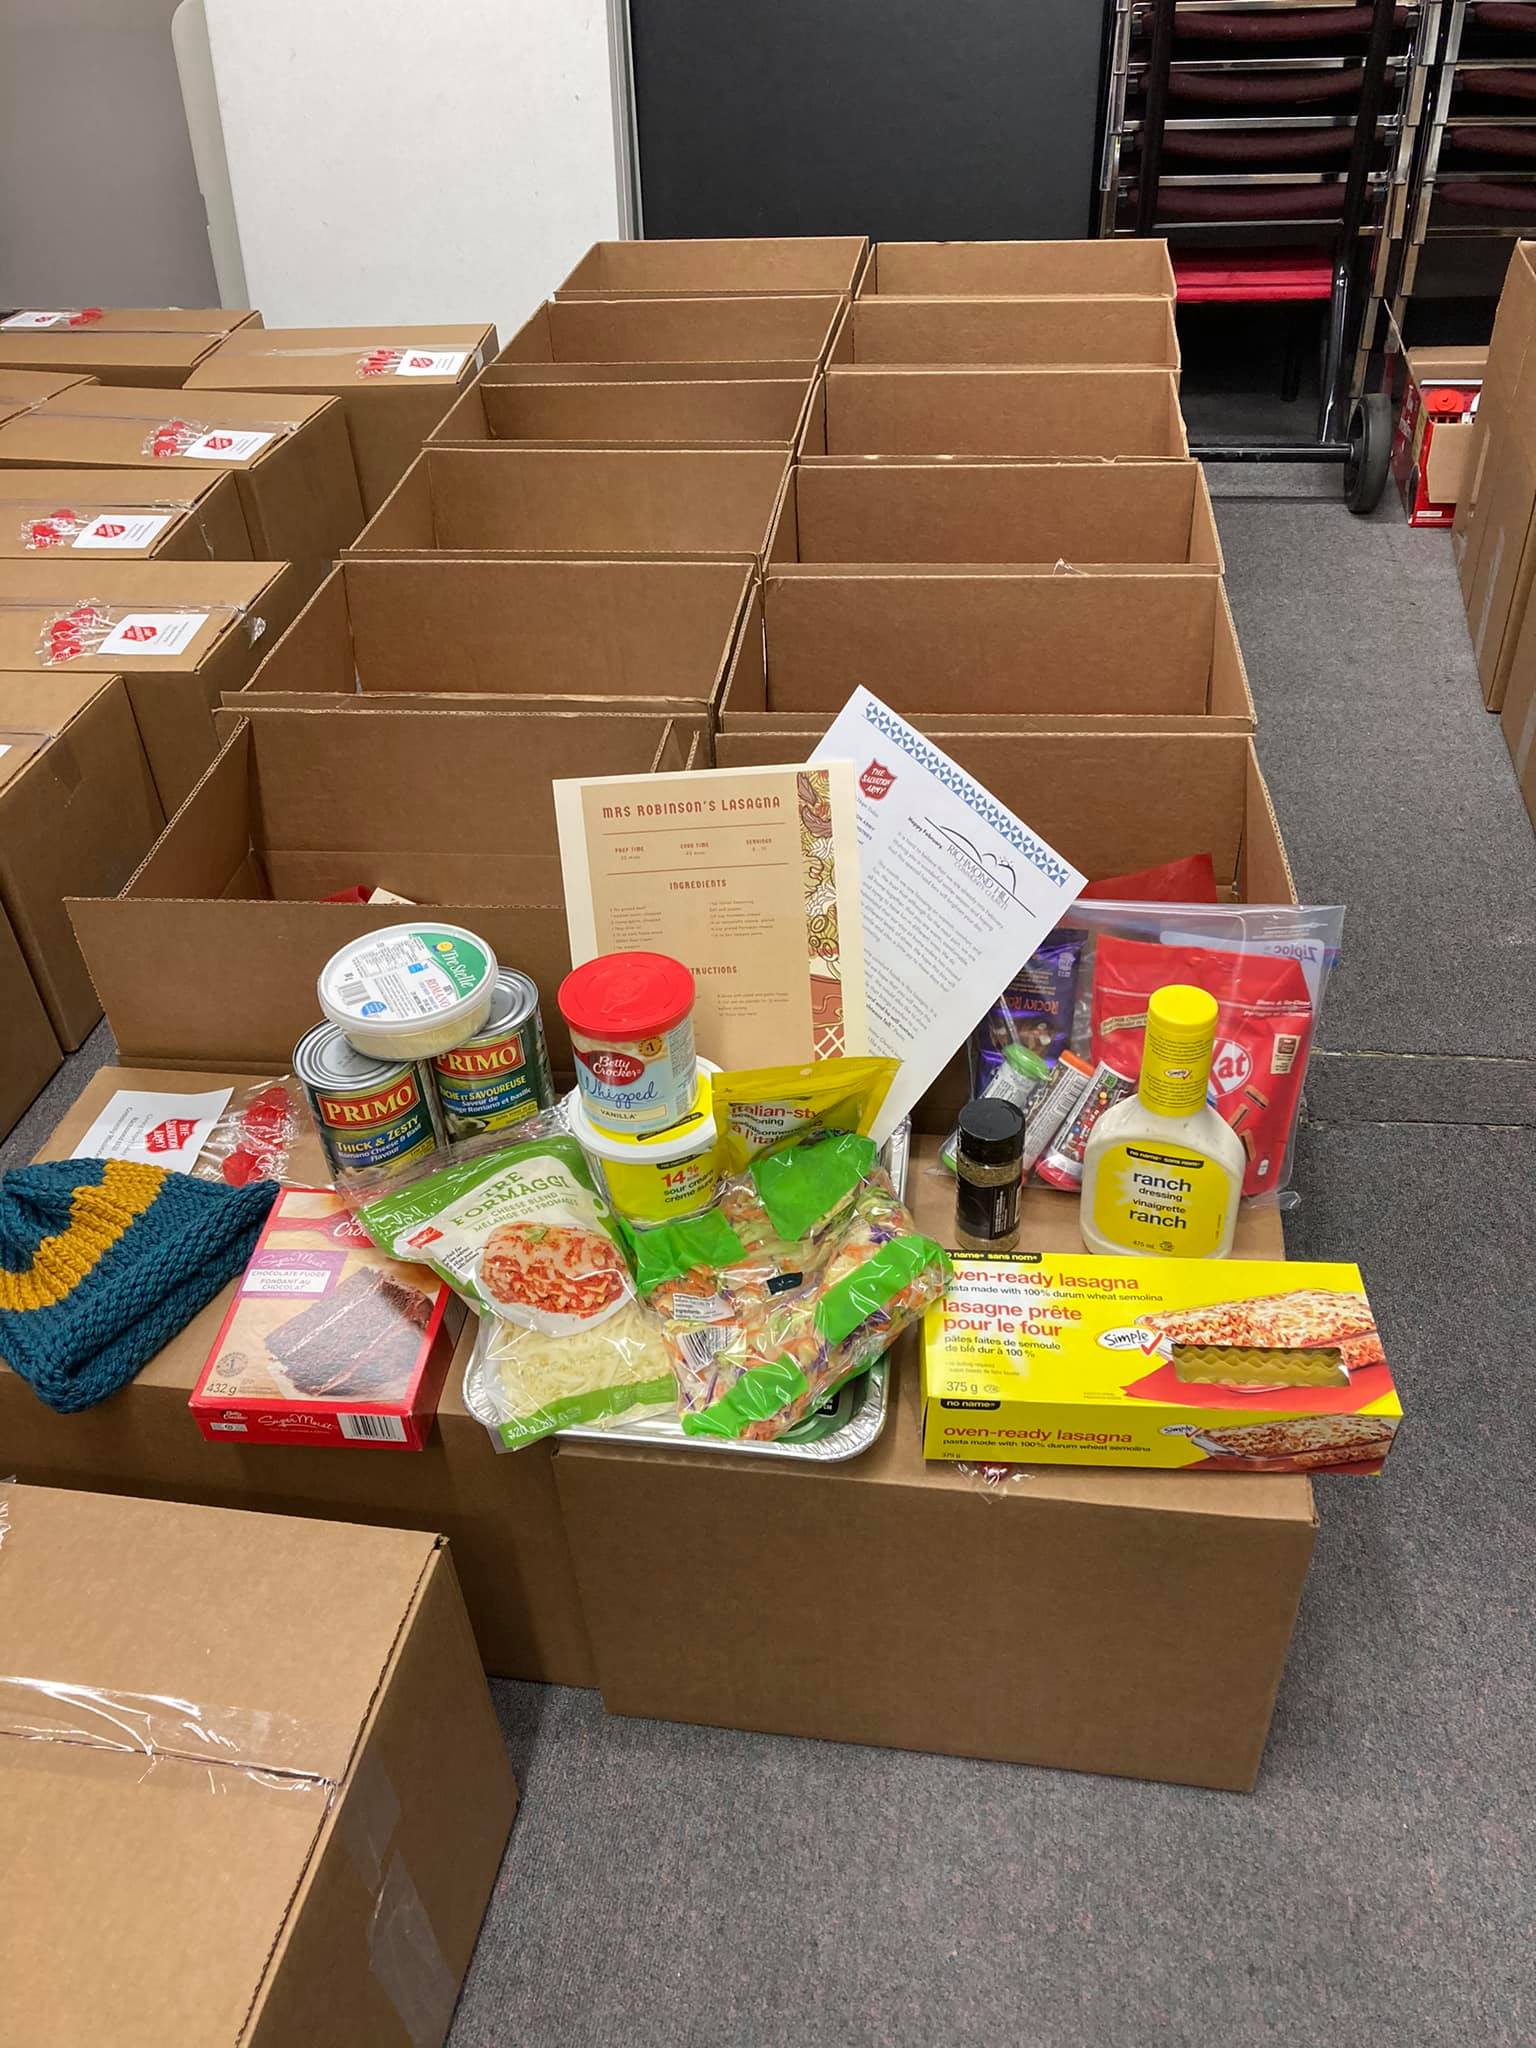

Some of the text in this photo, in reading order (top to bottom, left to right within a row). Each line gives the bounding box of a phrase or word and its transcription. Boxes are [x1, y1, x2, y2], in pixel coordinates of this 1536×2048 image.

[603, 796, 781, 819] MRS ROBINSON'S LASAGNA
[946, 844, 994, 889] RICHMOND
[669, 879, 727, 890] INGREDIENTS
[690, 965, 737, 976] TRUCTIONS
[436, 1046, 517, 1073] PRIMO
[599, 1056, 630, 1070] Betty
[592, 1062, 637, 1078] Crocker
[469, 1075, 527, 1100] SAVOUREUSE
[579, 1070, 658, 1109] Whipped
[326, 1085, 413, 1122] PRIMO
[461, 1095, 498, 1108] Saveur de
[468, 1101, 501, 1113] Romano
[500, 1097, 510, 1106] et
[600, 1108, 636, 1120] VANILLA
[179, 1123, 190, 1137] THE
[336, 1115, 419, 1154] THICK & ZESTY
[370, 1140, 400, 1156] Cheese
[370, 1147, 401, 1163] Flavour
[479, 1171, 525, 1199] TRE
[663, 1183, 687, 1196] sour
[1133, 1171, 1192, 1193] ranch
[451, 1175, 571, 1227] FORMAGGI
[1138, 1187, 1183, 1203] dressing
[490, 1192, 559, 1217] CHEESE BLEND
[522, 1206, 534, 1216] DE
[1132, 1198, 1187, 1216] vinaigrette
[1129, 1207, 1187, 1230] ranch
[953, 1252, 982, 1261] name
[987, 1253, 1010, 1261] sans
[1012, 1254, 1035, 1262] nom
[952, 1270, 1139, 1293] ven-ready lasagna
[947, 1285, 1164, 1302] asta made with 100% durum wheat semolina
[943, 1298, 1083, 1322] lasagne prête
[943, 1318, 1063, 1337] pour le four
[944, 1335, 1061, 1350] pâtes faites de semoule
[1104, 1331, 1150, 1347] Simple
[959, 1344, 976, 1353] blé
[977, 1346, 994, 1355] dur
[996, 1347, 1004, 1356] à
[1006, 1348, 1023, 1357] 100
[206, 1383, 238, 1396] 432 g
[946, 1381, 978, 1394] 375 g
[946, 1400, 991, 1410] no name
[943, 1427, 1133, 1444] oven-ready lasagna
[942, 1438, 969, 1447] pasta
[970, 1439, 997, 1447] made
[997, 1440, 1019, 1448] with
[1020, 1441, 1046, 1449] 100%
[1047, 1442, 1080, 1450] durum
[1081, 1444, 1108, 1452] wheat
